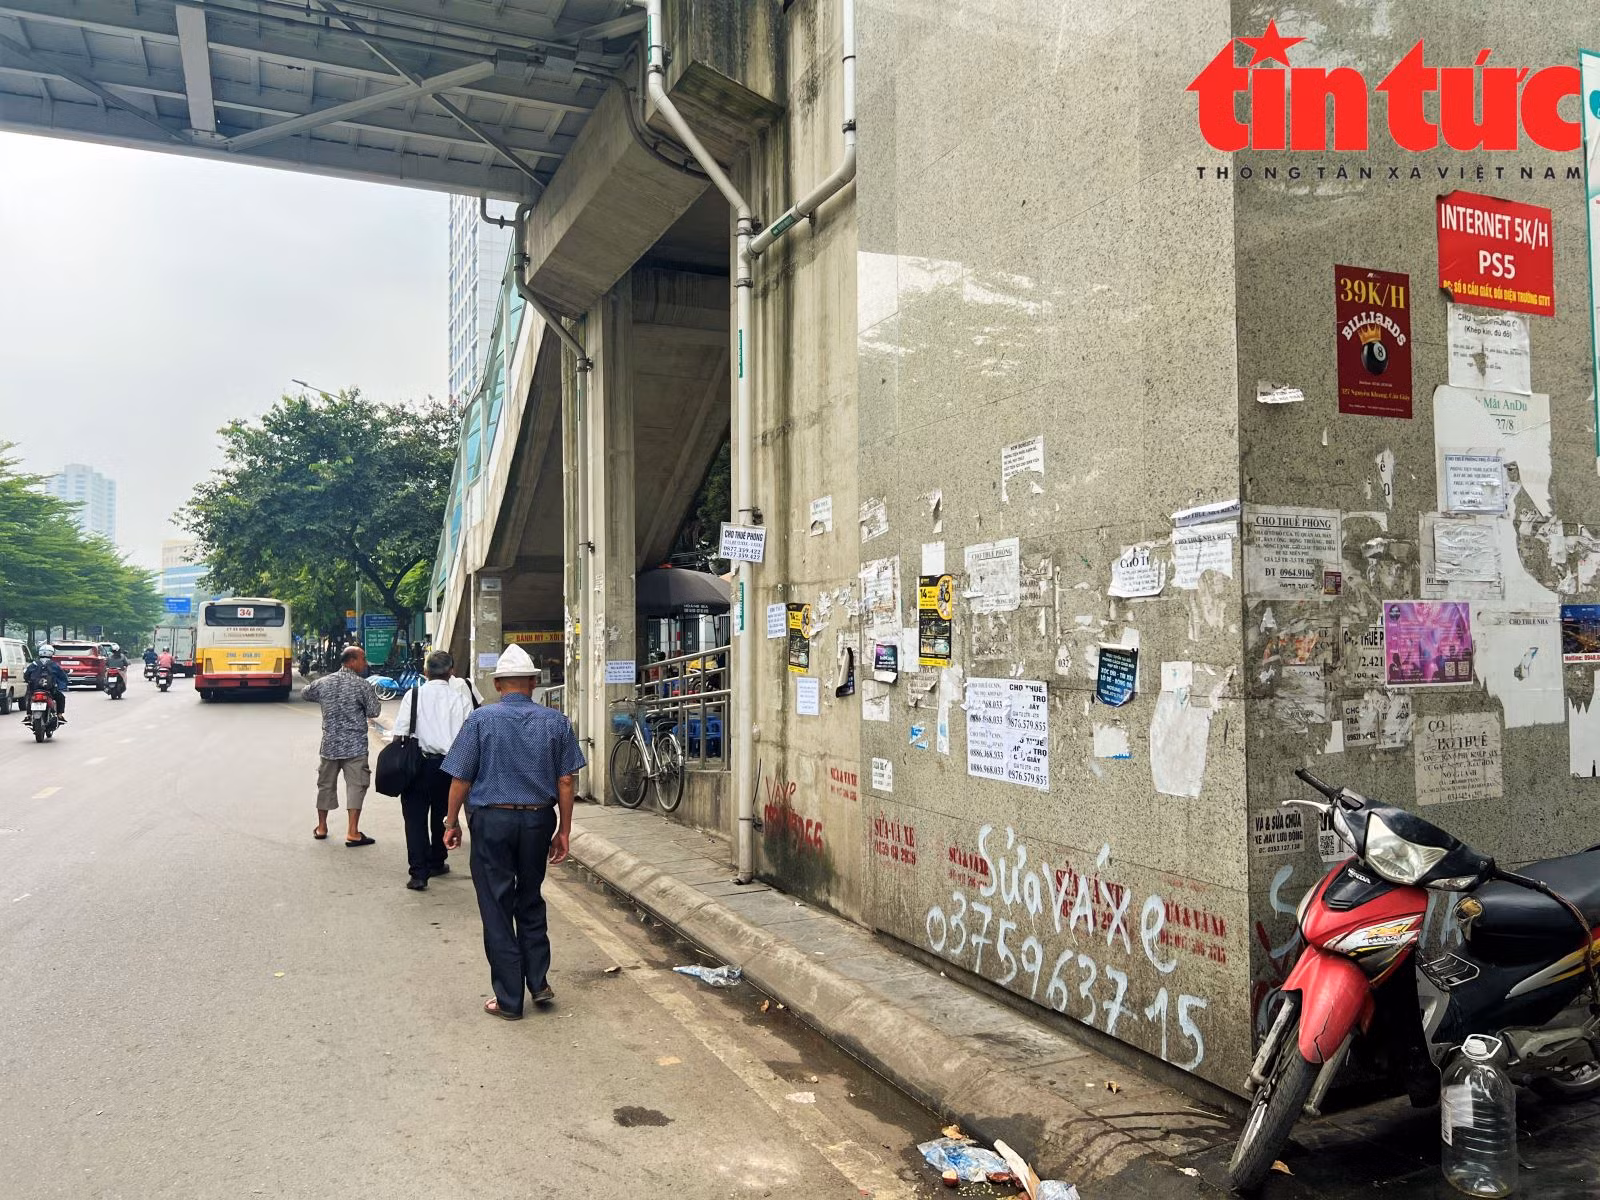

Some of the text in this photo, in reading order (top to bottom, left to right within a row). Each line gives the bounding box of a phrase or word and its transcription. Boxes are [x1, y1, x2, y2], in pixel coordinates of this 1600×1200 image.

[1441, 203, 1549, 250] INTERNET 5K/H
[1479, 250, 1516, 279] PS5
[1340, 278, 1405, 309] 39K/H
[1256, 515, 1331, 528] CHO THUÊ PHÒNG
[725, 530, 734, 538] CHO
[735, 530, 746, 540] THUÊ
[1265, 568, 1276, 576] ĐT
[239, 609, 252, 617] 34
[1034, 748, 1047, 756] TRỌ
